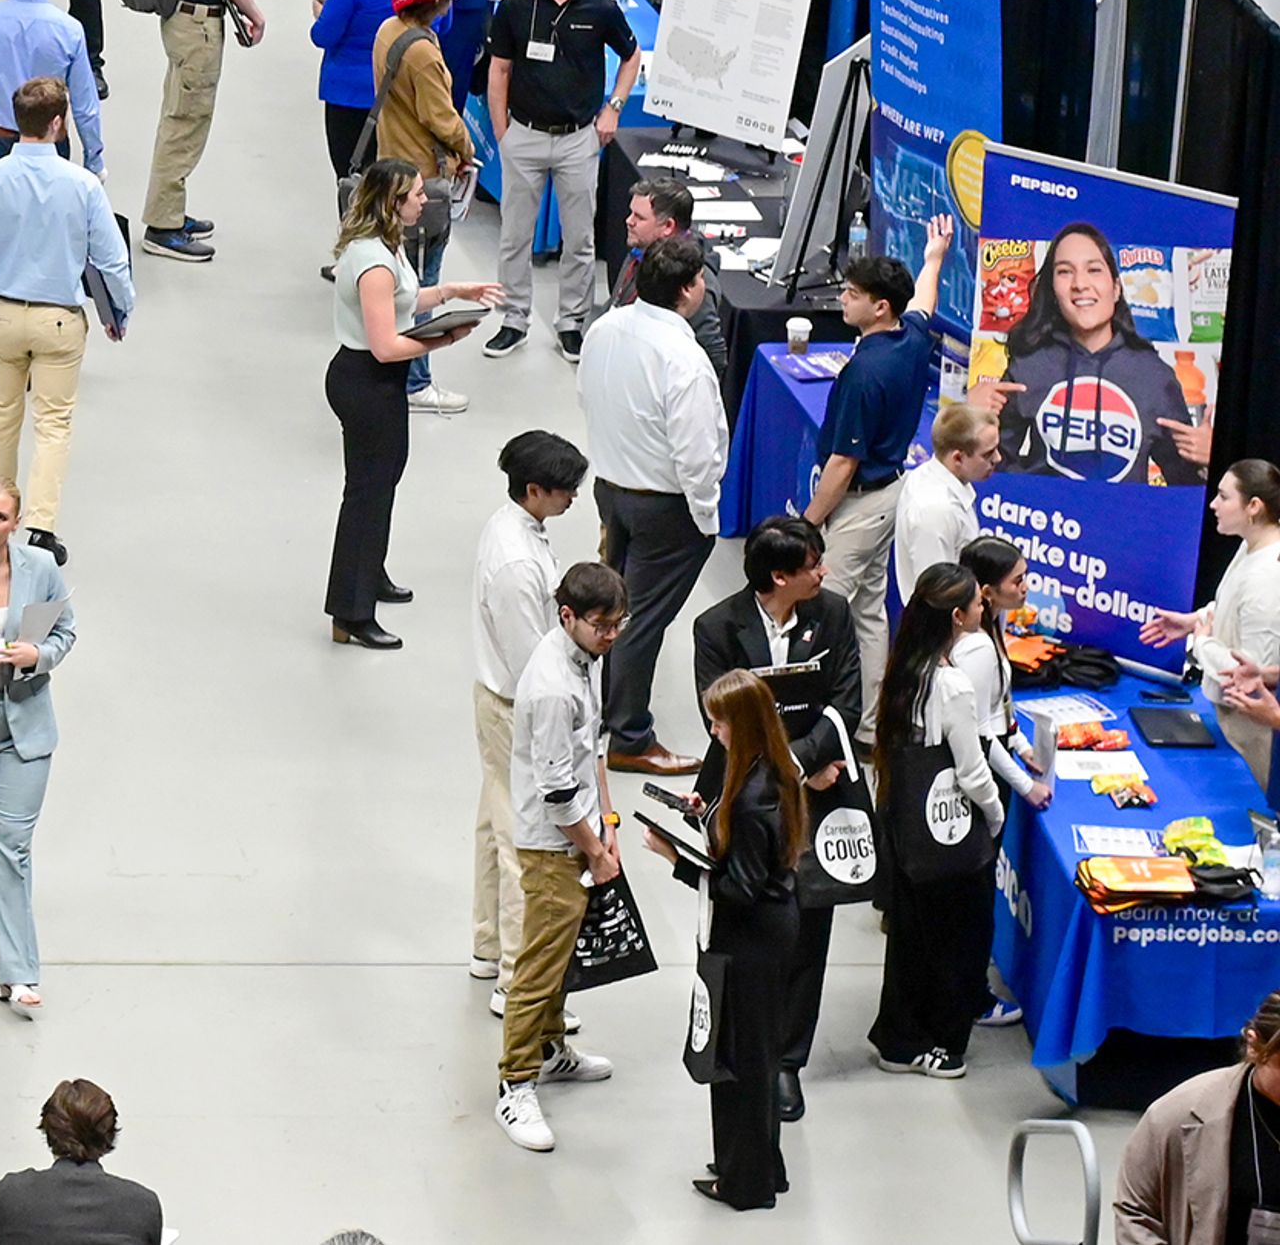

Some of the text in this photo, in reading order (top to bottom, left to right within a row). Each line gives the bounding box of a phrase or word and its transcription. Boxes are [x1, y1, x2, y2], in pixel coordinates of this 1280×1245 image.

[881, 0, 945, 45] Technical Consulting
[881, 20, 918, 54] Sustainability
[881, 39, 919, 74] Credit Analyst
[881, 58, 928, 96] Paid Internships
[660, 98, 674, 109] RTX
[881, 100, 945, 145] WHERE ARE WE?
[1010, 173, 1079, 200] PEPSICO
[983, 239, 1031, 267] Cheetos
[1119, 247, 1165, 267] RUFFLES
[1131, 306, 1159, 319] ORIGINAL
[1042, 411, 1138, 451] PEPSI
[980, 493, 1082, 541] dare to
[1069, 551, 1107, 585] up
[1025, 570, 1159, 625] on-dollar
[824, 834, 874, 861] COUGS
[1174, 906, 1231, 924] more
[1236, 903, 1260, 923] at
[1113, 923, 1280, 948] pepsicojobs.co
